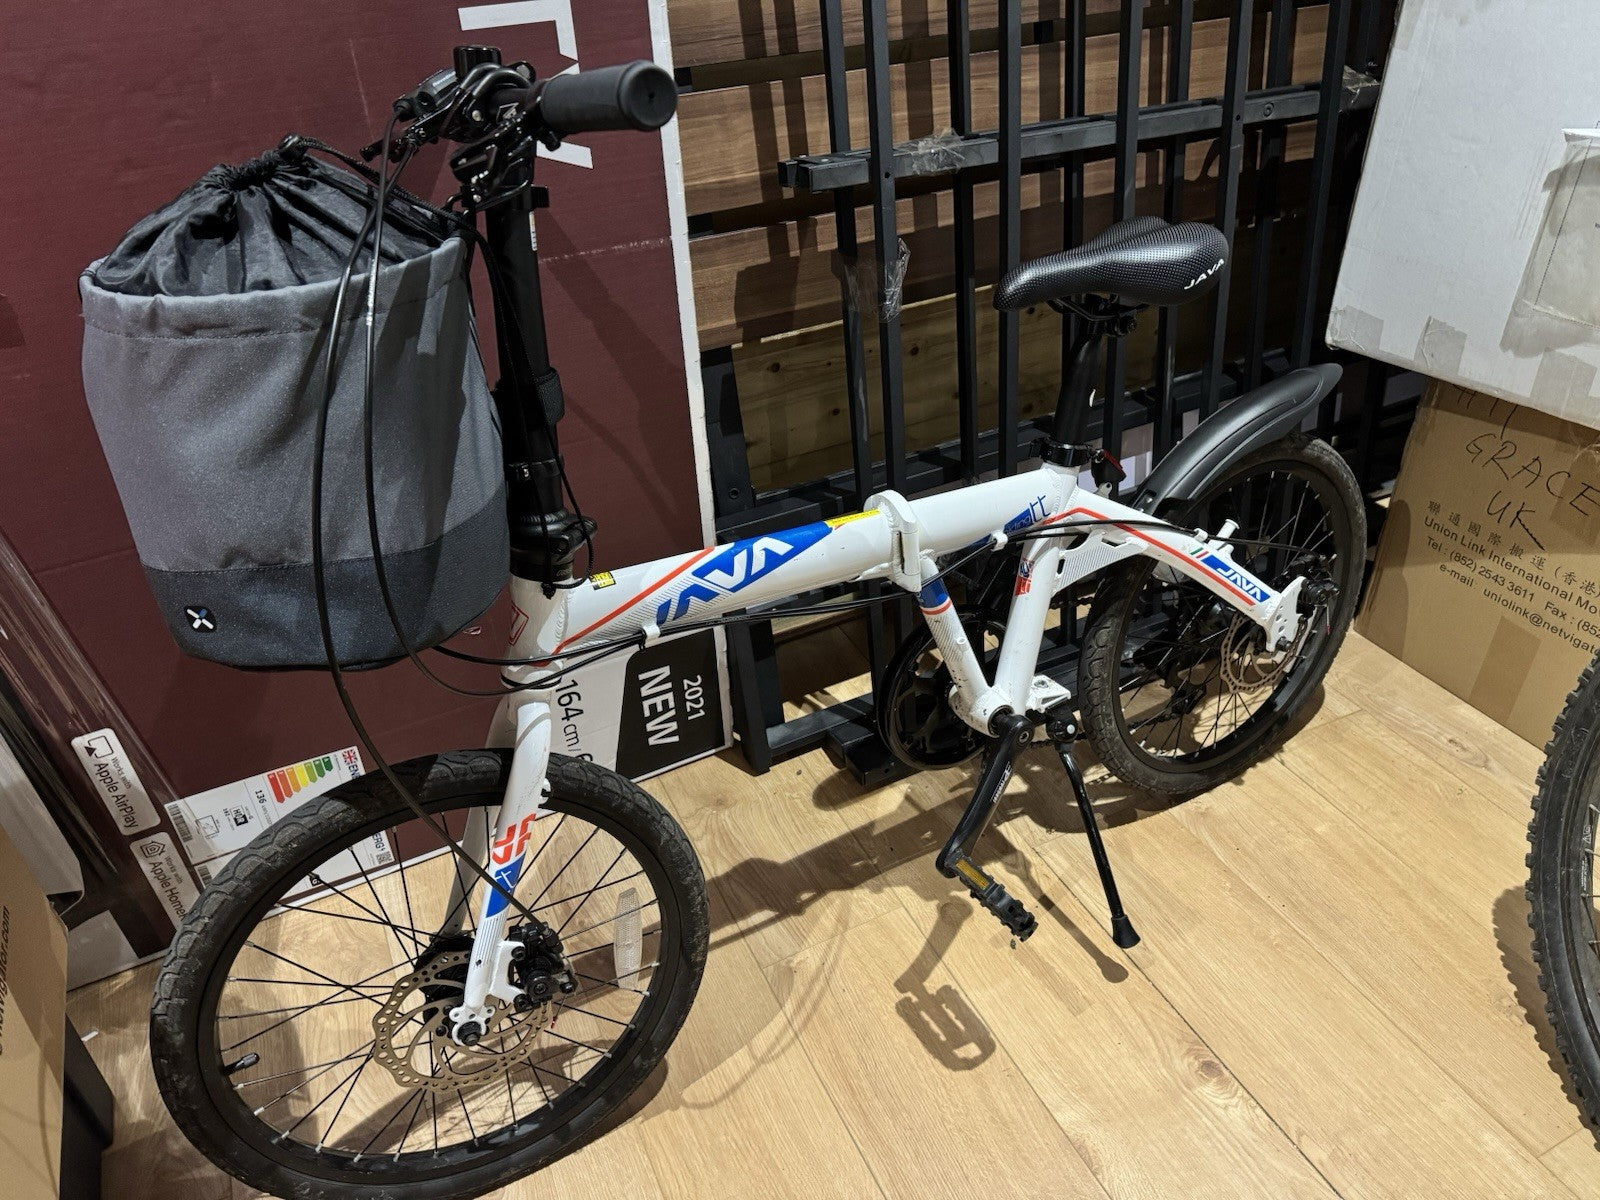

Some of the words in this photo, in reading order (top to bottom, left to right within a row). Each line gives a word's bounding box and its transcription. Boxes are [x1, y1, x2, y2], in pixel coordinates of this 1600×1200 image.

[1184, 259, 1224, 289] JAVA
[1466, 433, 1600, 516] GRACE
[1487, 491, 1545, 550] UK
[656, 536, 794, 626] JAVA
[1216, 566, 1262, 602] JAVA
[1424, 516, 1458, 541] Union
[1460, 534, 1486, 555] Link
[1488, 550, 1573, 602] International
[1575, 595, 1600, 615] Mo
[1450, 550, 1477, 572] (852)
[1478, 565, 1505, 587] 2543
[1507, 581, 1535, 602] 3611
[1544, 600, 1567, 620] Fax
[555, 679, 584, 722] 164
[638, 665, 680, 746] NEW
[683, 674, 706, 721] 2021
[94, 763, 119, 793] Apple
[112, 794, 139, 828] AirPlay
[255, 790, 267, 804] 136
[149, 861, 172, 888] Apple
